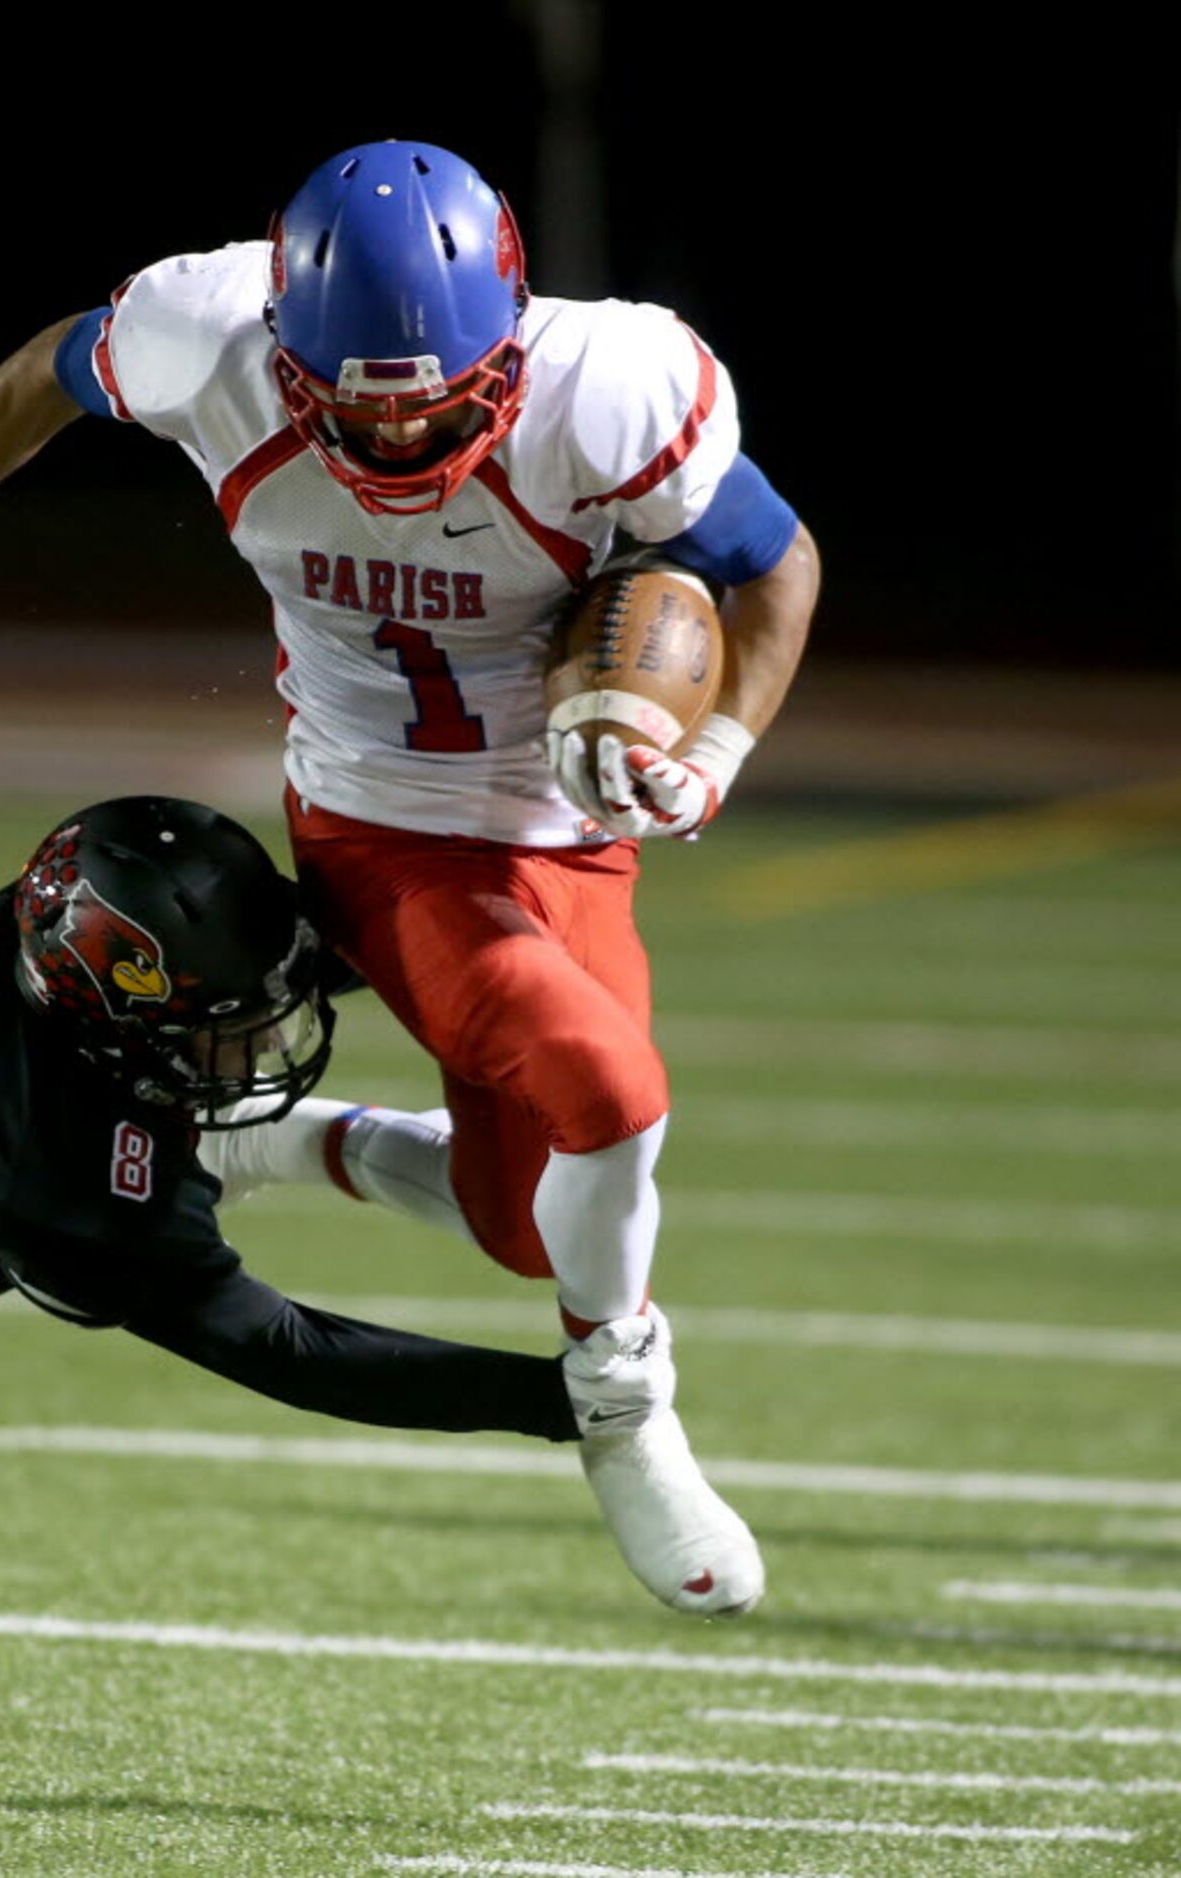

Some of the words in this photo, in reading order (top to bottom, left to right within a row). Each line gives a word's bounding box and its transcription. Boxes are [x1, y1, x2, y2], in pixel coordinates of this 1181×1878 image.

[300, 550, 487, 621] PARISH
[372, 619, 487, 753] 1
[110, 1120, 155, 1202] 8
